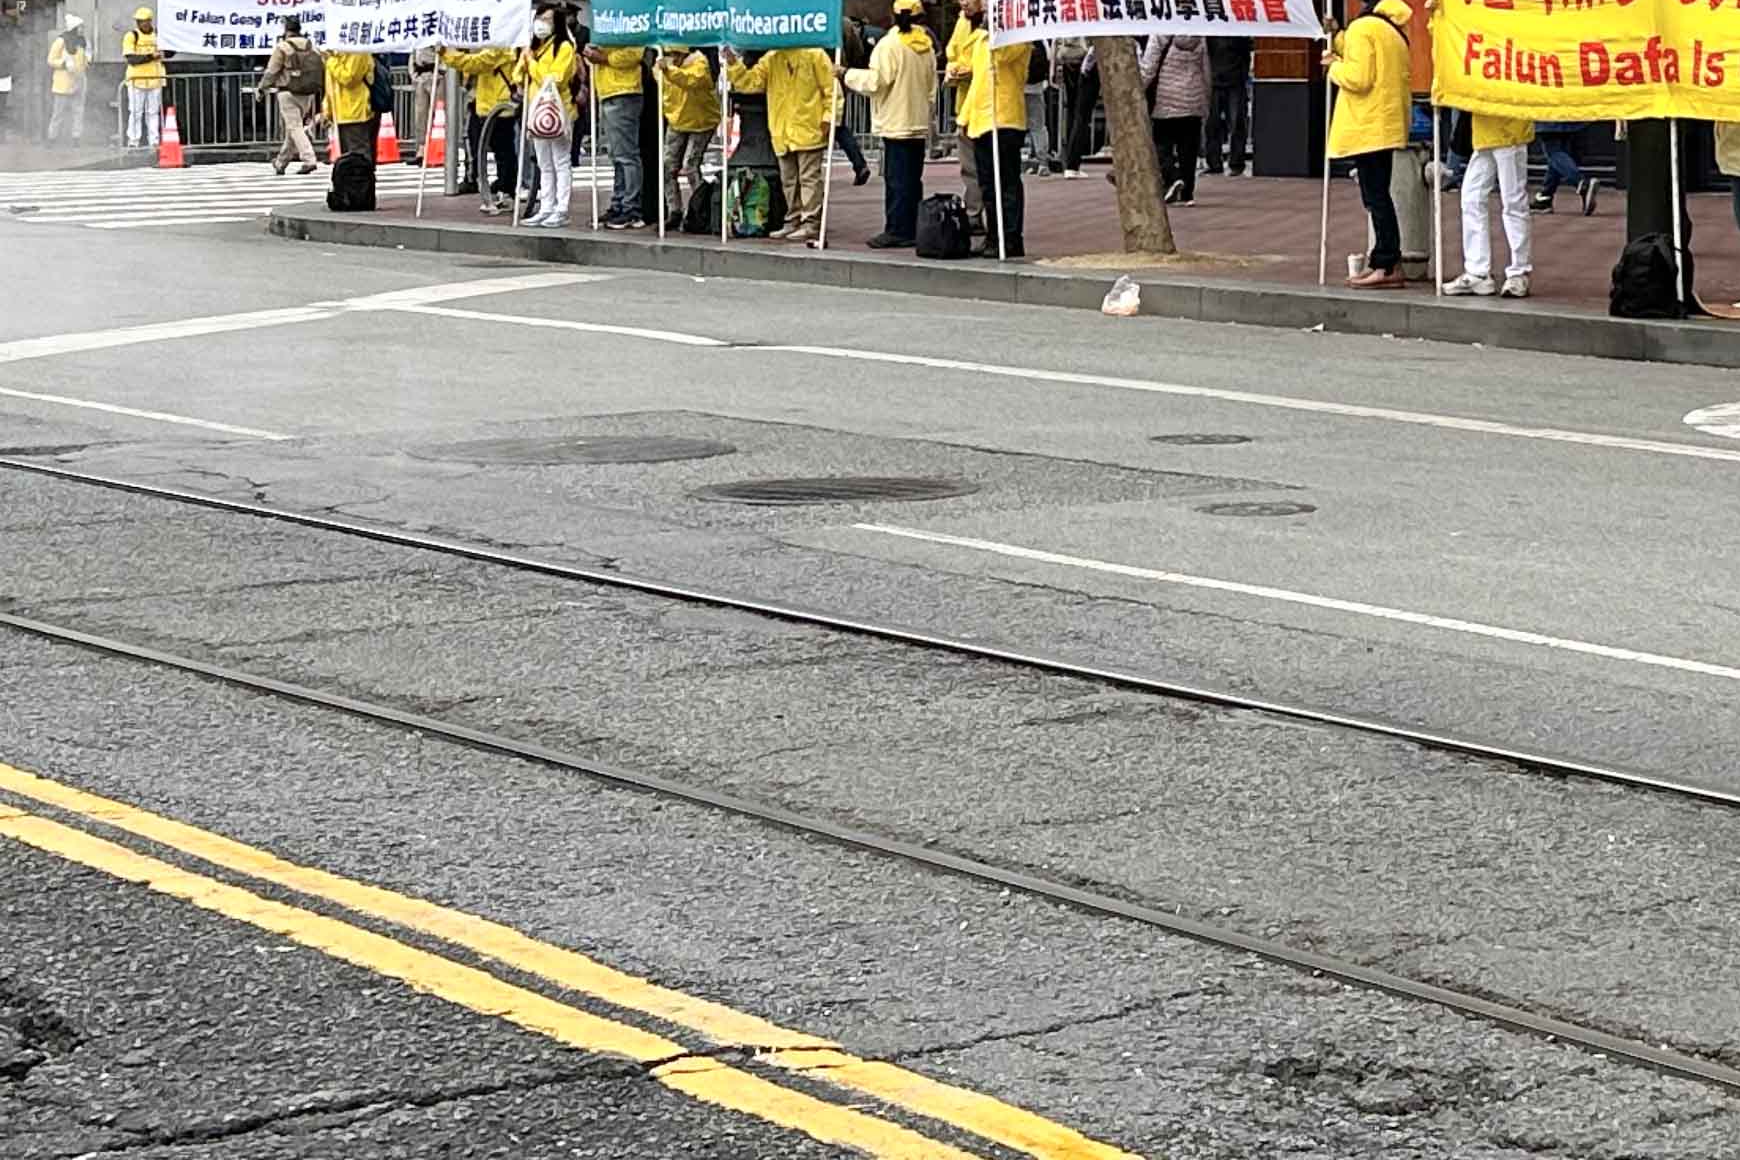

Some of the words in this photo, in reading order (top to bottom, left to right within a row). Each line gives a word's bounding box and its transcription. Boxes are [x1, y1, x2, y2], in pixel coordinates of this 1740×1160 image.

[1463, 33, 1564, 89] Falun
[1578, 35, 1681, 87] Dafa
[1691, 40, 1725, 89] Is
